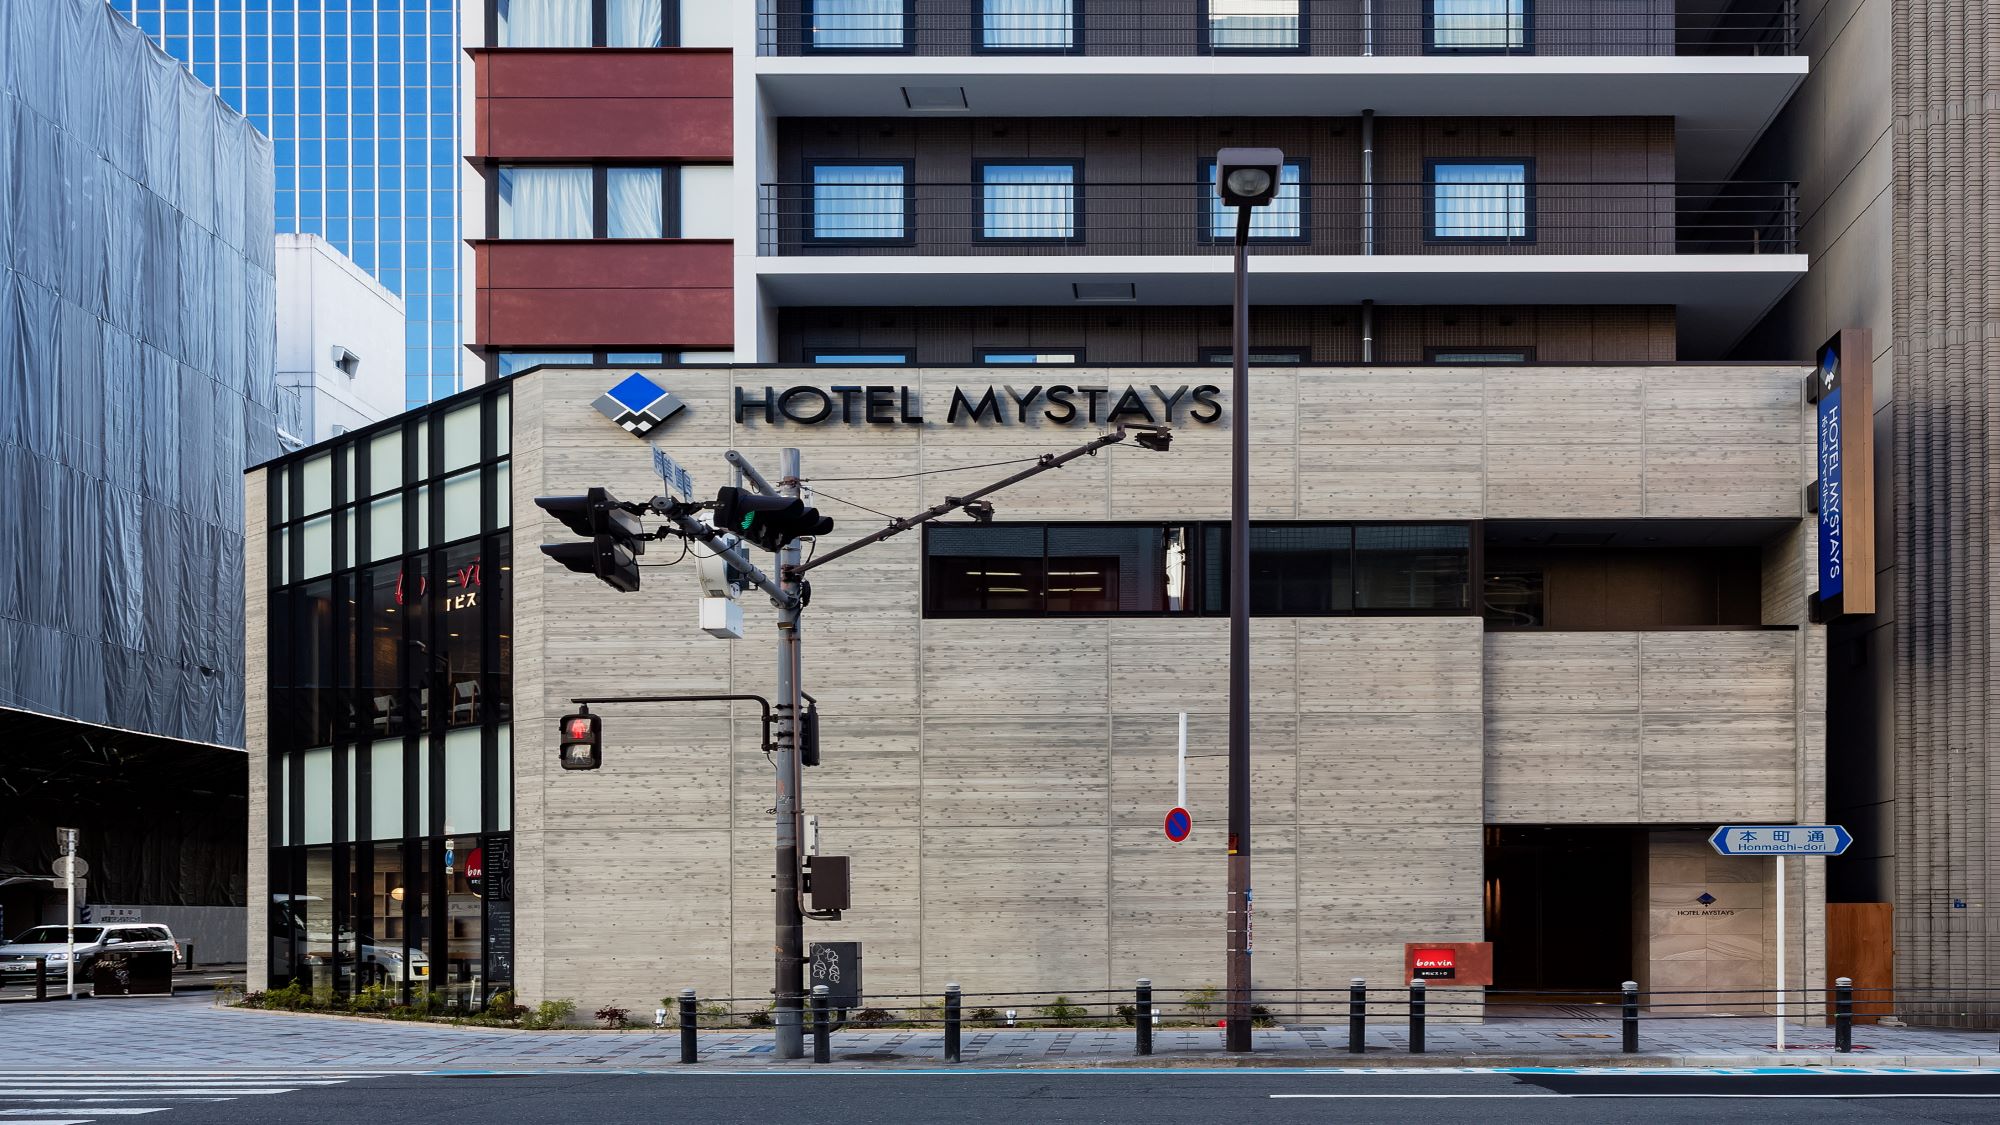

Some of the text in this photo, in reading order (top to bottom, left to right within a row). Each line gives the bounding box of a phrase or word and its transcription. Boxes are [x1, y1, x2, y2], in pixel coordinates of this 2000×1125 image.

[734, 384, 1222, 425] HOTEL MYSTAYS
[1828, 405, 1840, 579] HOTEL MYSTAYS
[1739, 830, 1825, 843] 本町通
[1738, 843, 1826, 851] Honmachi-dori
[1416, 958, 1452, 967] bon vin
